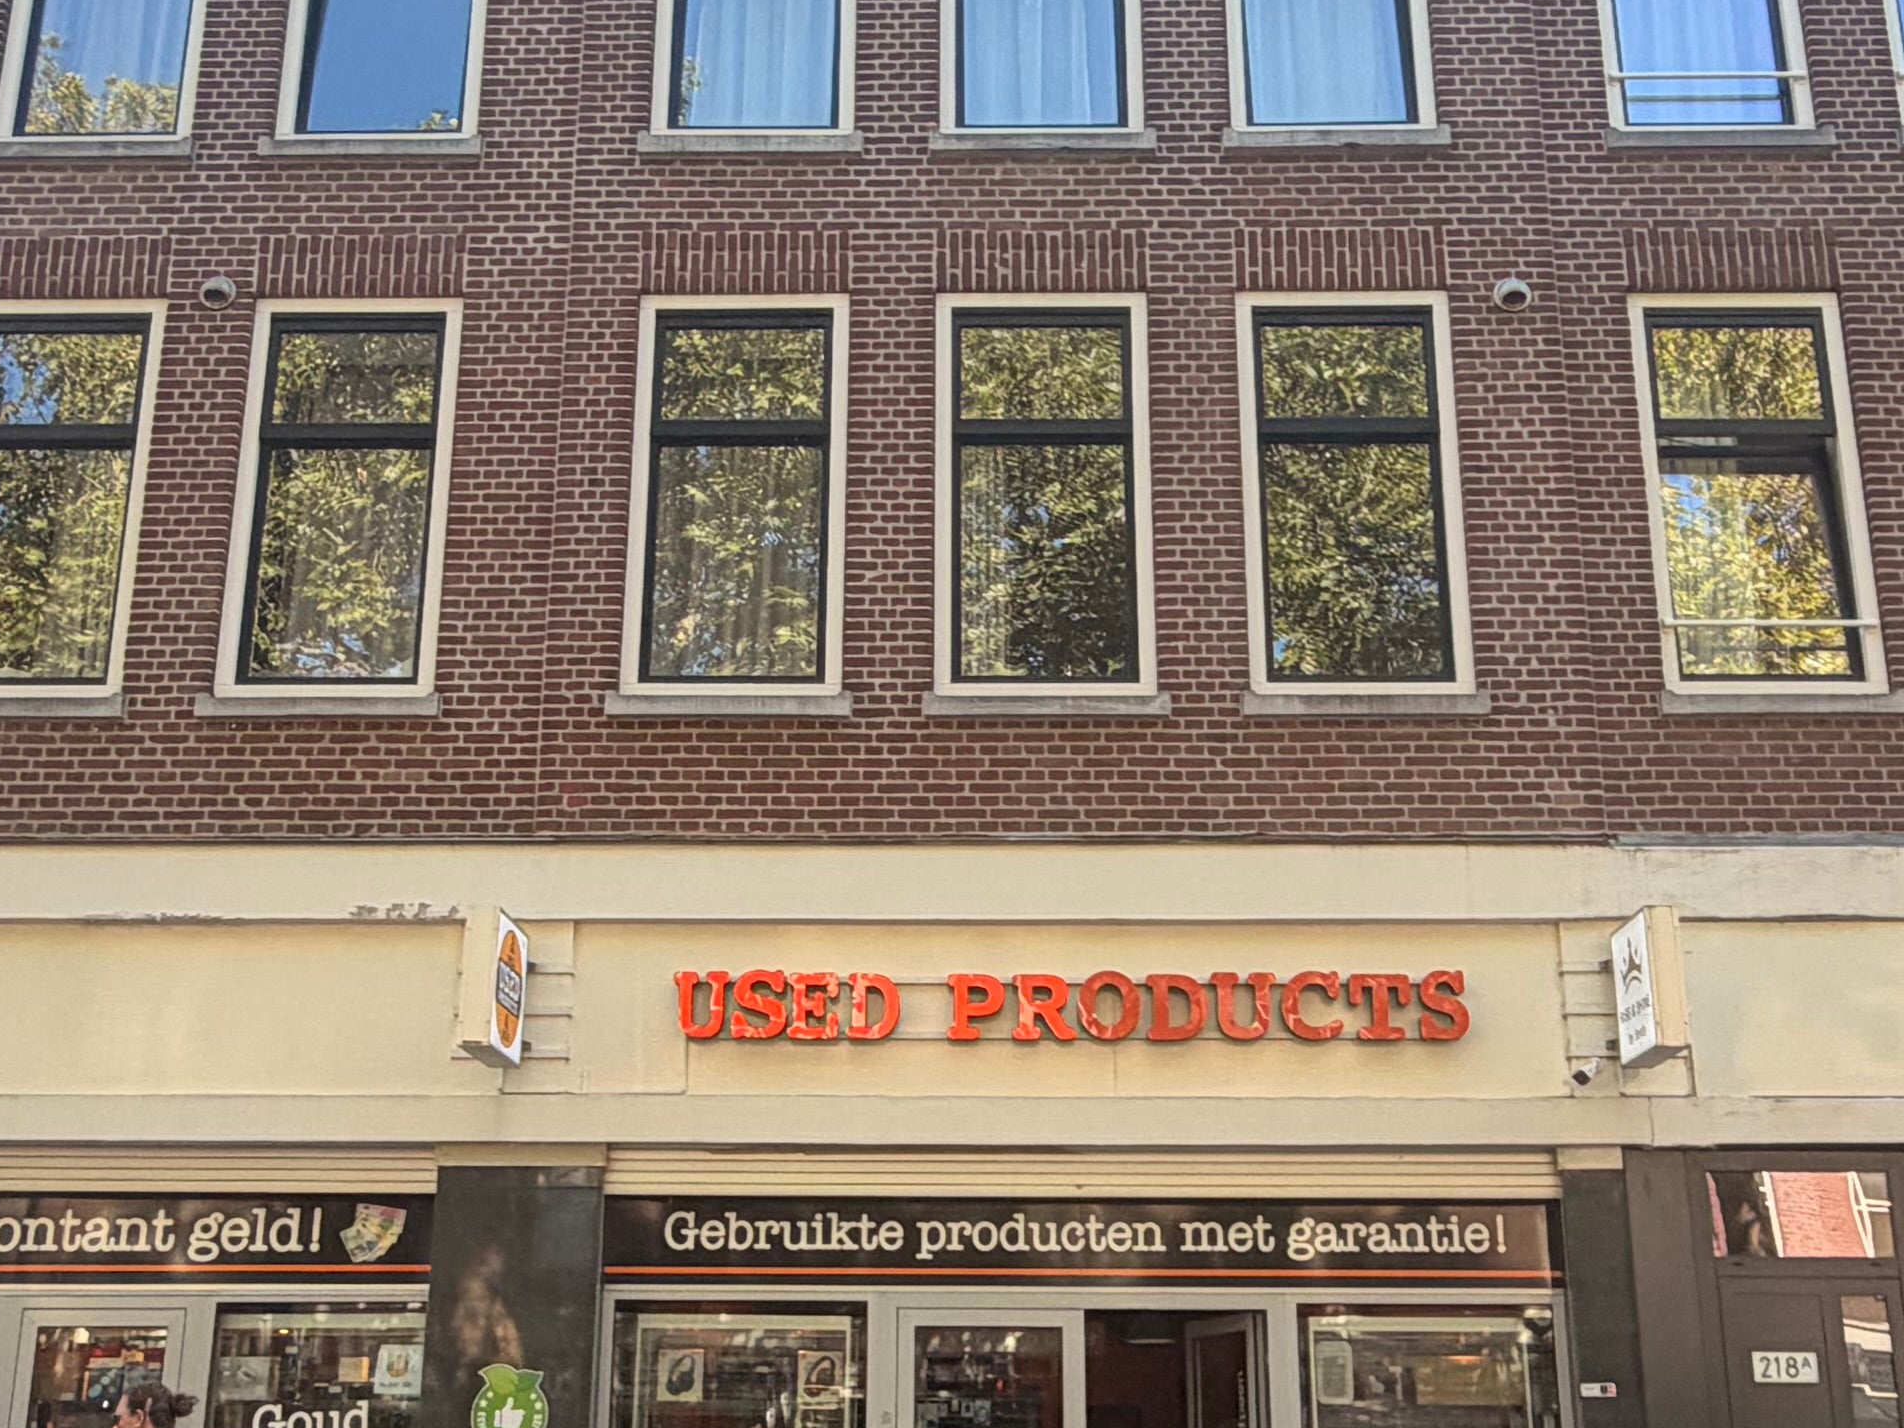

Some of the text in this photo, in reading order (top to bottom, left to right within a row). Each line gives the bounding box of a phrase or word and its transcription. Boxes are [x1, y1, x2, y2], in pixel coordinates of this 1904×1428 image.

[674, 969, 1471, 1042] USED PRODUCTS
[186, 1207, 323, 1262] geld!
[663, 1211, 1507, 1261] Gebruikte producten met garantie!
[1759, 1356, 1813, 1379] 218A
